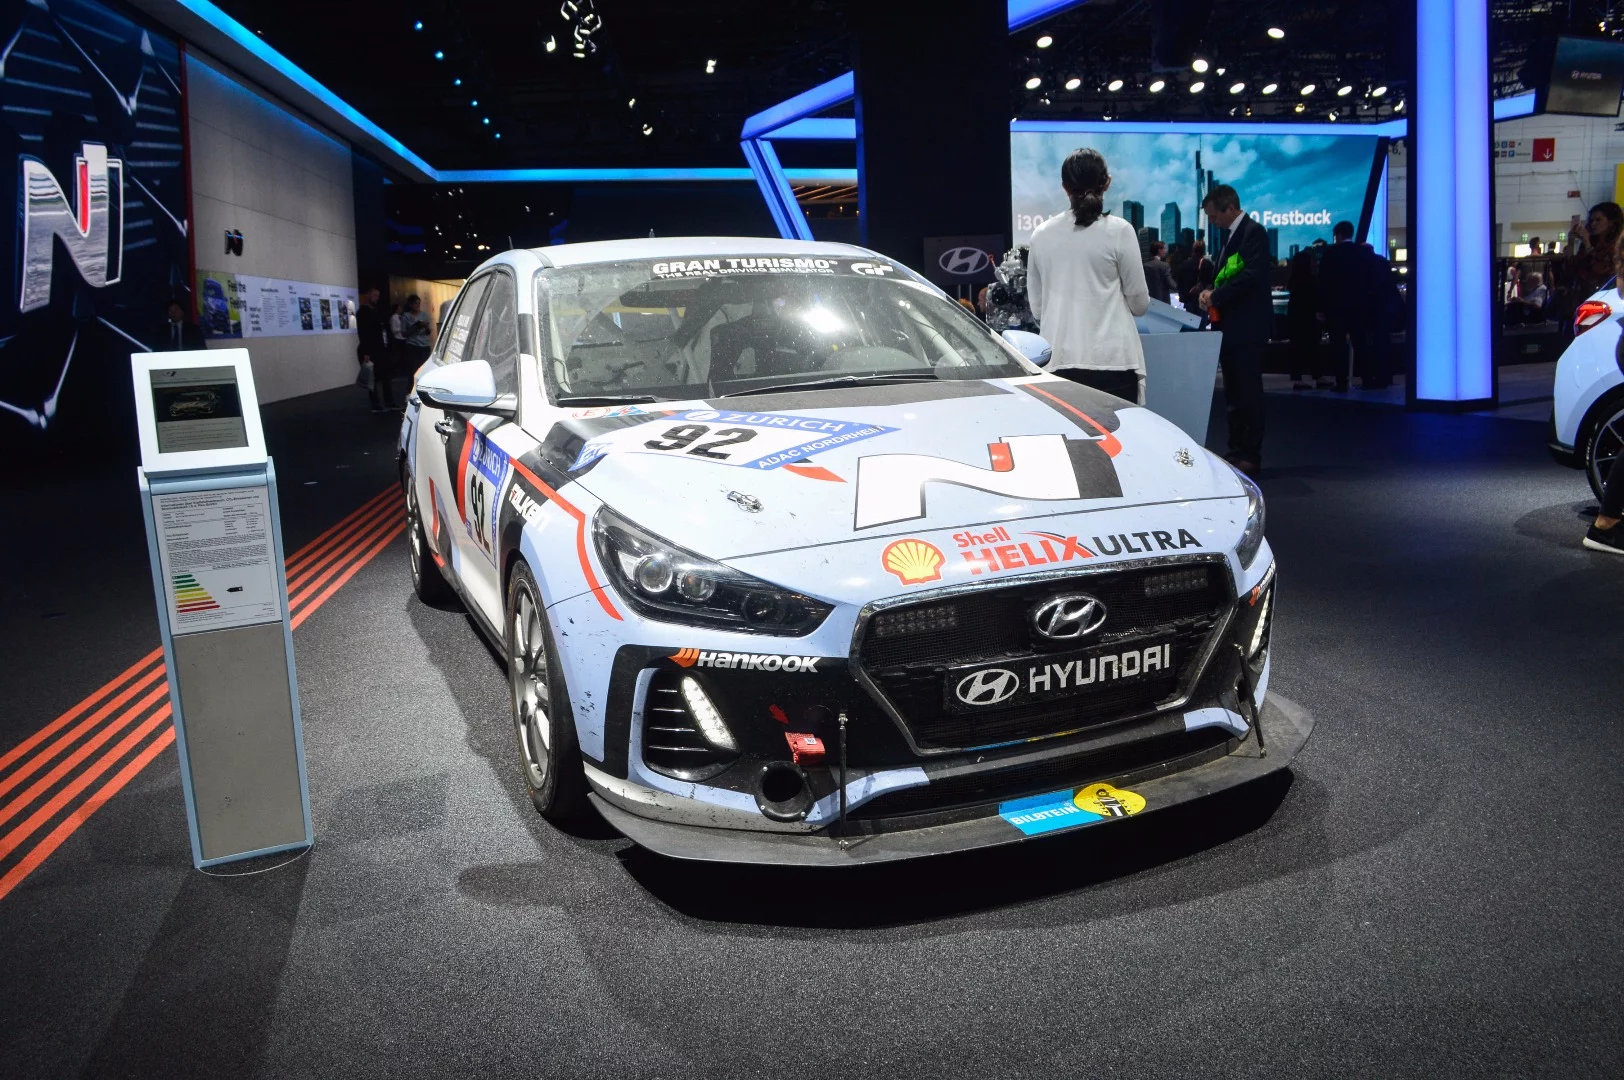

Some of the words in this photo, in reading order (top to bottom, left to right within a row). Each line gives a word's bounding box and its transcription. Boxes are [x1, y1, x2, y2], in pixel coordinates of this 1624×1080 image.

[1262, 208, 1332, 226] Fastback
[652, 259, 721, 275] GRAN
[726, 258, 830, 269] TURISMO
[686, 269, 718, 277] REAL
[722, 412, 847, 432] ZURICH
[642, 424, 759, 461] 92
[757, 449, 803, 469] ADAC
[470, 473, 492, 556] 92
[952, 525, 1011, 548] Shell
[960, 535, 1096, 575] HELIX
[1092, 528, 1203, 556] ULTRA
[1029, 643, 1171, 693] HYUNDAI
[1009, 803, 1082, 826] BILSTEIN
